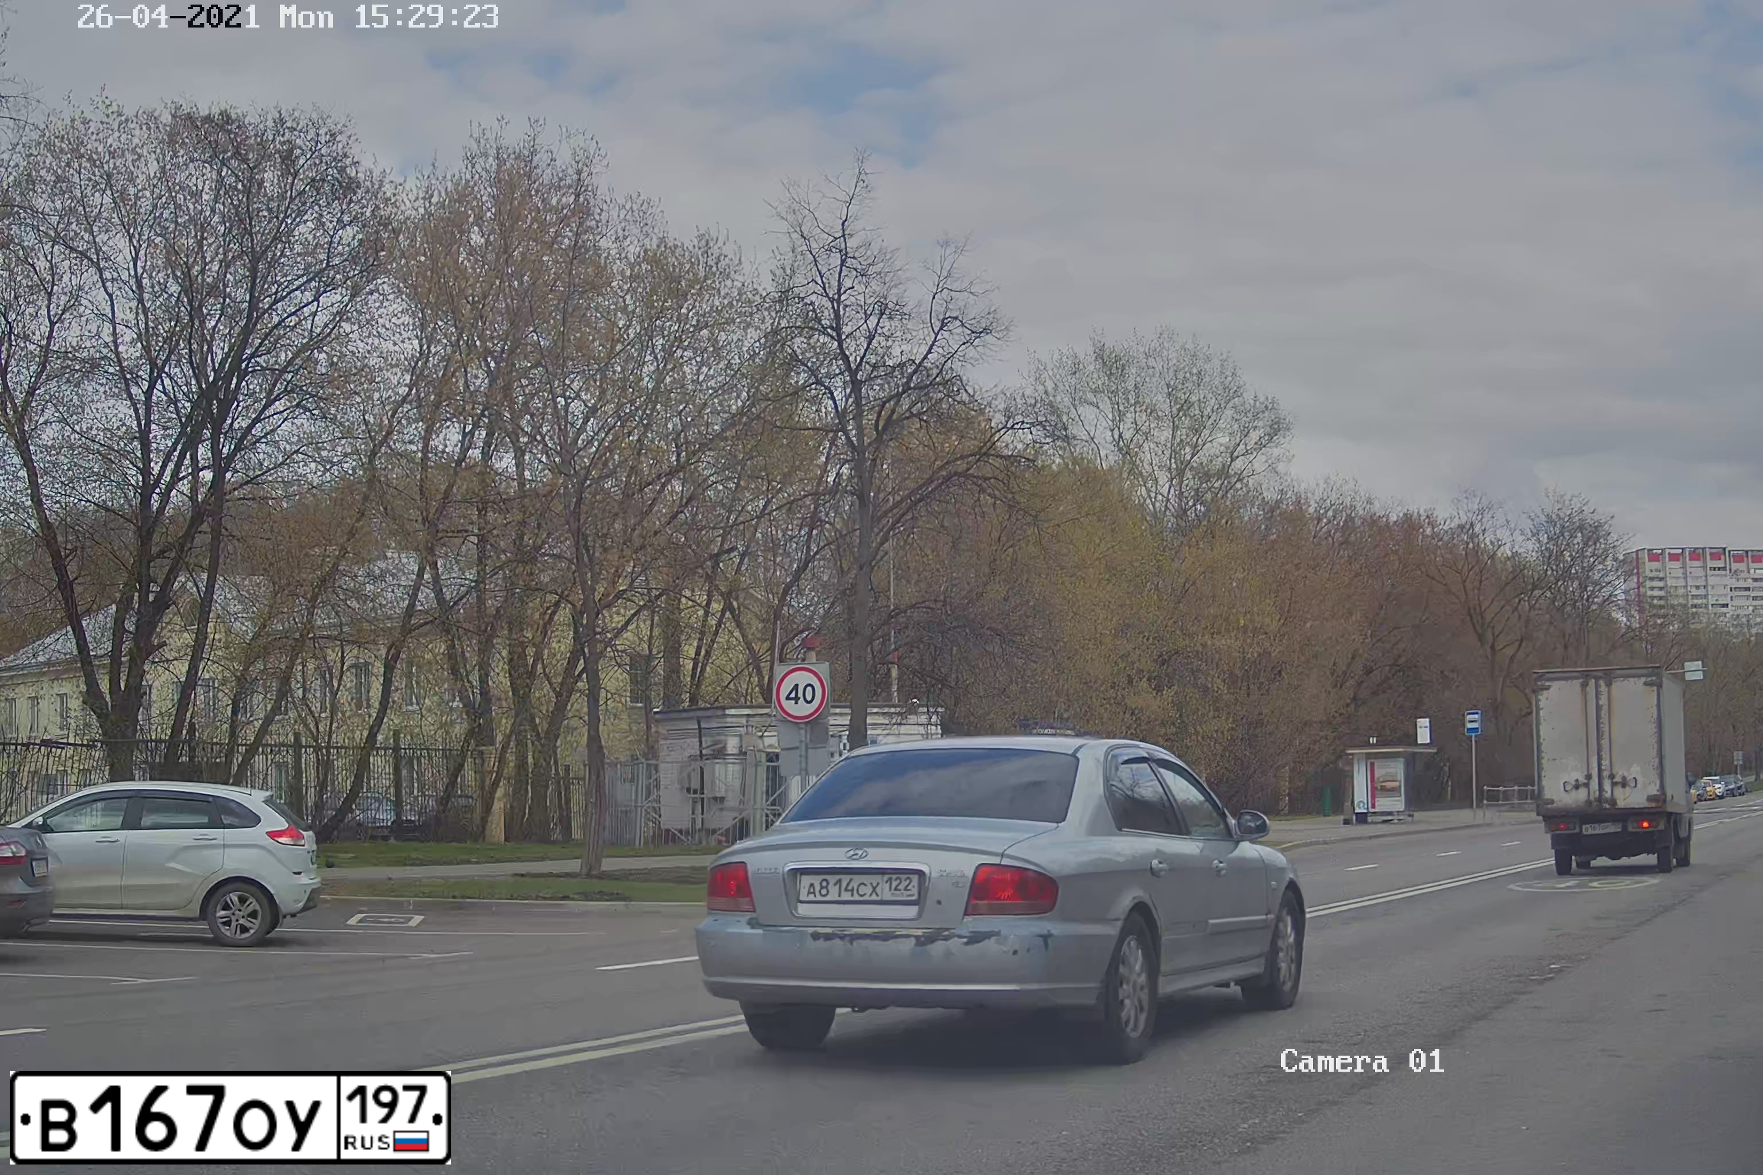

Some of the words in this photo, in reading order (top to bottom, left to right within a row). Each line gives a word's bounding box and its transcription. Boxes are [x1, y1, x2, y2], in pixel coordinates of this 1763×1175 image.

[785, 683, 816, 705] 40
[806, 878, 880, 898] А814СХ
[885, 876, 913, 892] 122
